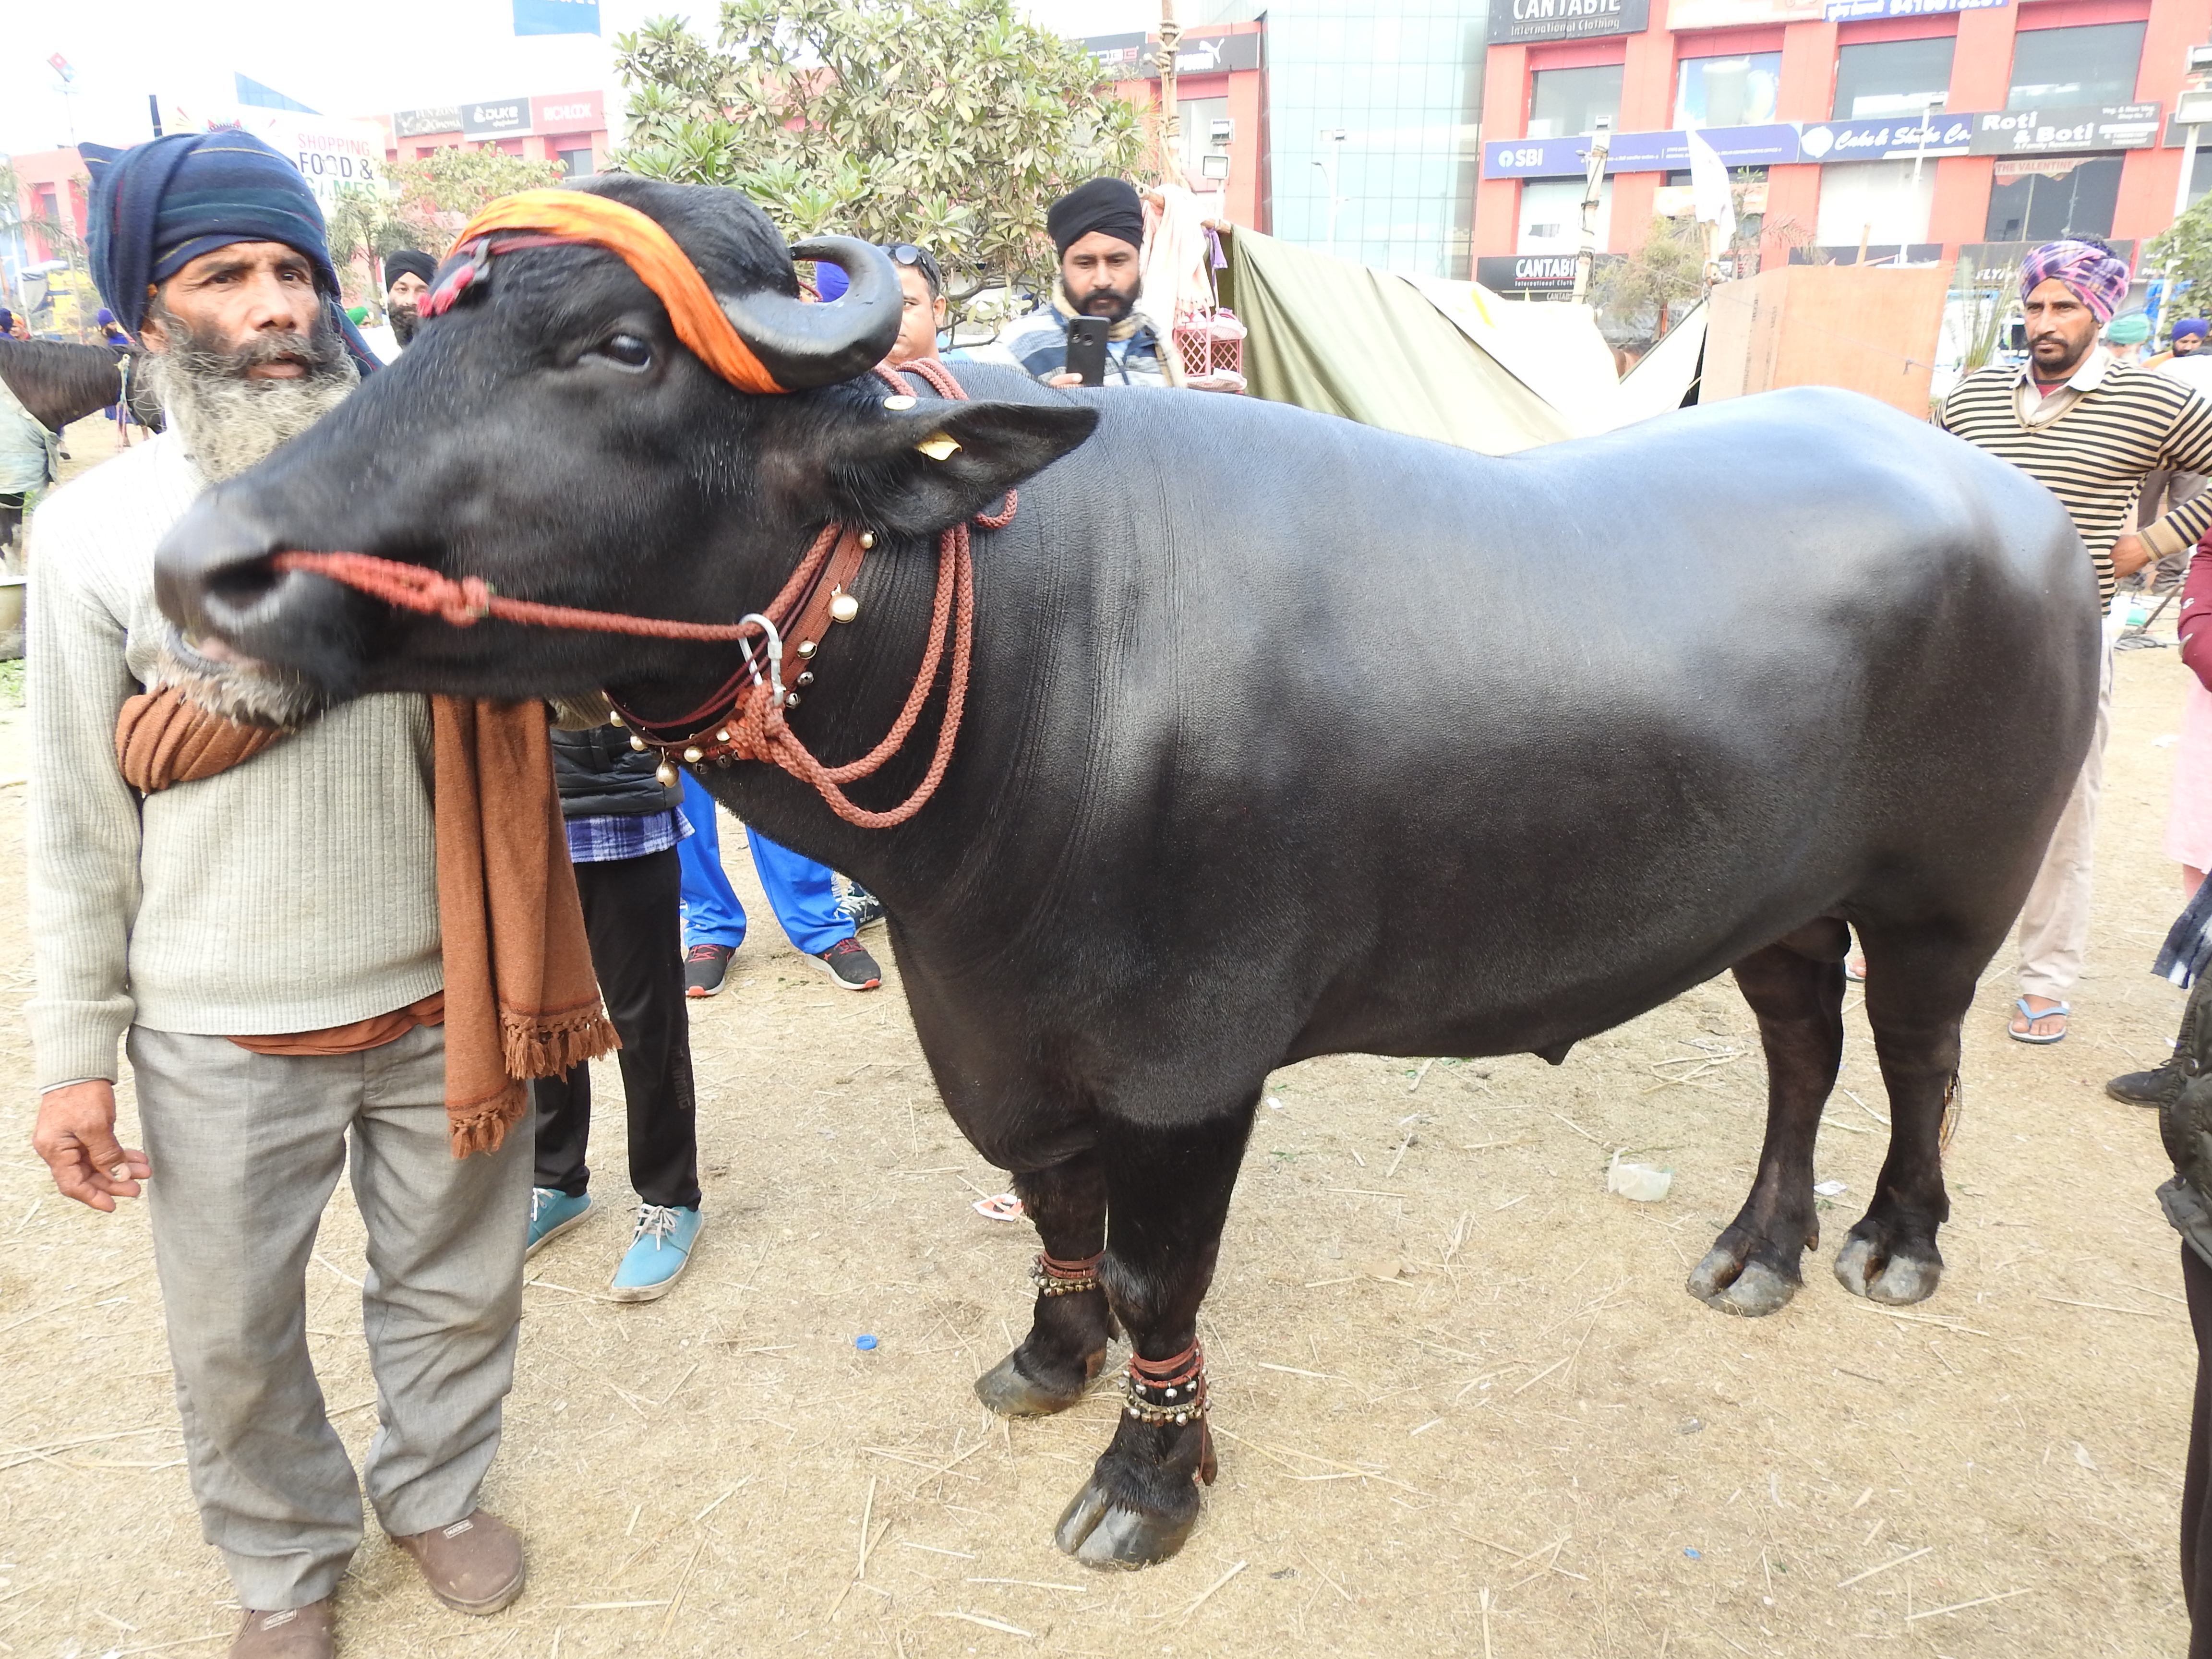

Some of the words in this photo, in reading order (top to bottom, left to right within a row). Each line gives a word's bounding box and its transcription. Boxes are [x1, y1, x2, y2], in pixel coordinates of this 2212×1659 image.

[1511, 22, 1575, 36] International
[1578, 18, 1620, 31] Clothing
[1175, 52, 1214, 72] PUMA
[543, 103, 592, 121] RICHLOOK
[1982, 111, 2038, 131] Roti
[2013, 130, 2031, 144] &
[2036, 122, 2095, 143] Boti
[298, 133, 370, 156] SHOPPING
[1515, 148, 1543, 167] SBI
[1996, 163, 2015, 172] THE
[2019, 159, 2073, 171] VALENTINE
[360, 159, 374, 180] &
[1515, 259, 1578, 278] CANTABI
